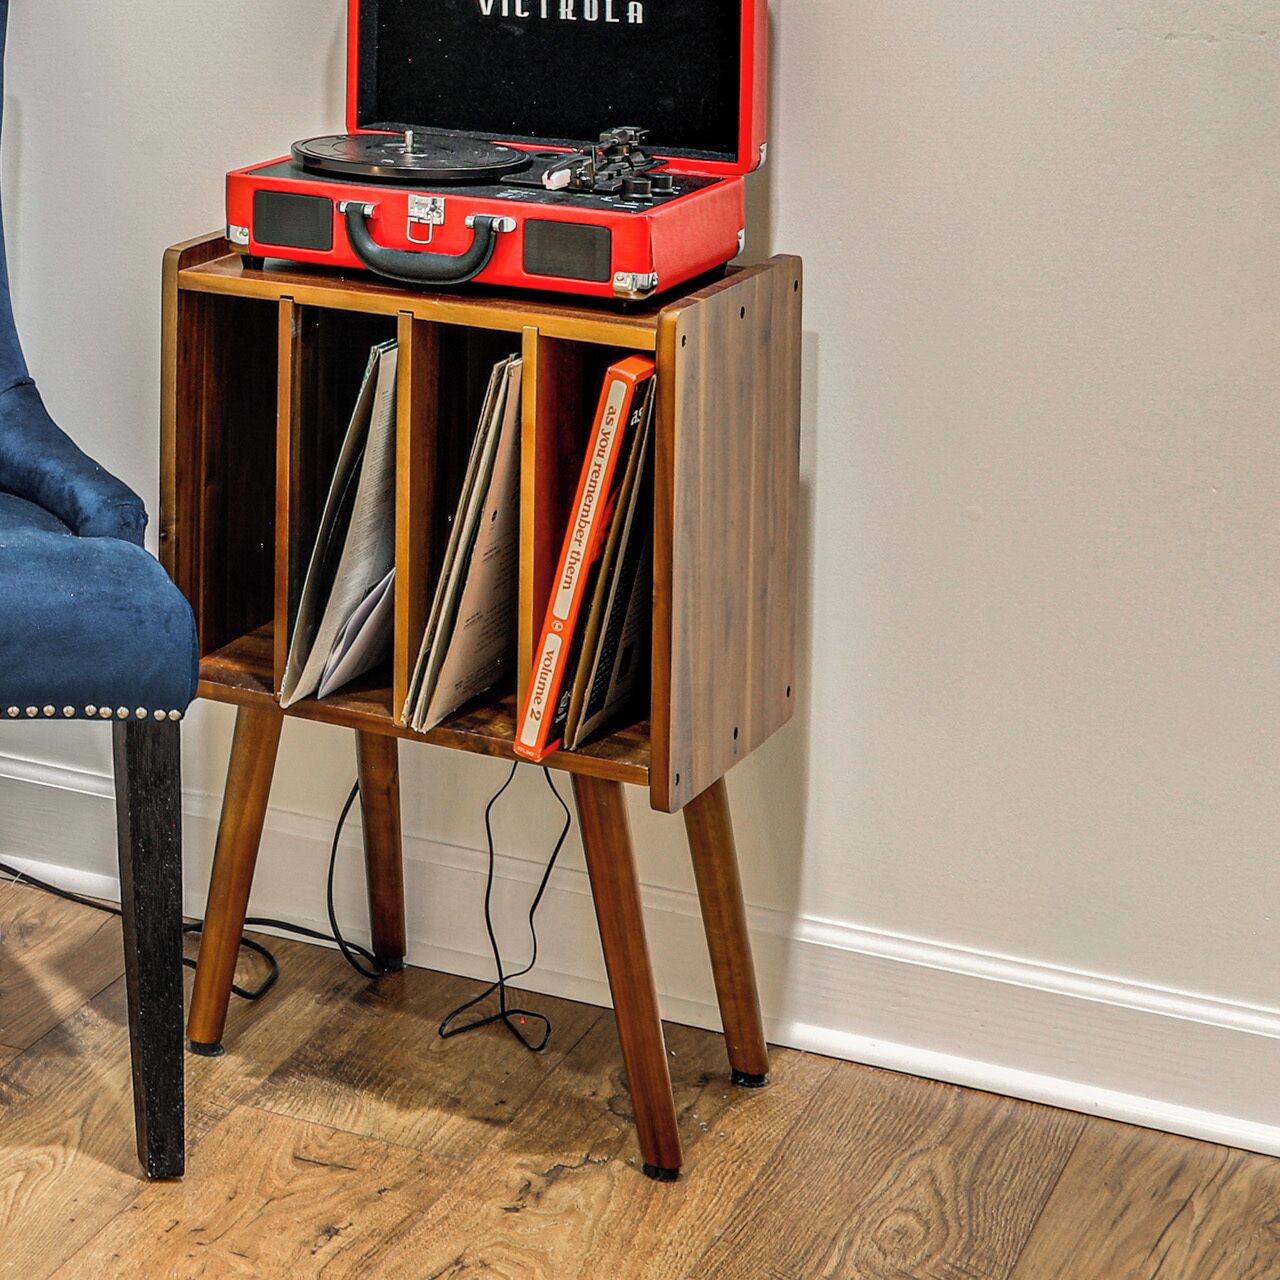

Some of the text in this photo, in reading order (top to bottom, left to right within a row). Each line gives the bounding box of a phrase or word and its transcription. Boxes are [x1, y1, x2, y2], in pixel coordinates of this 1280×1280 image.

[561, 404, 617, 592] as you remember them
[530, 649, 555, 721] volume 2
